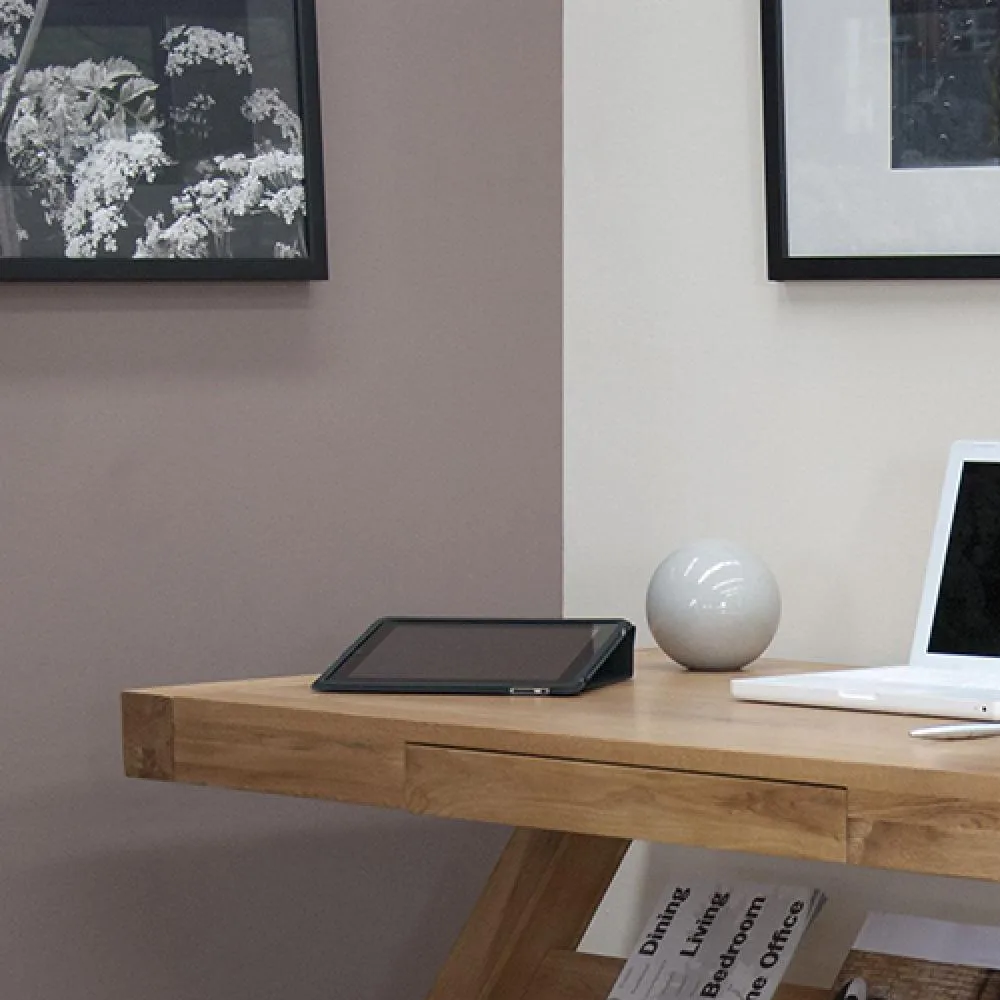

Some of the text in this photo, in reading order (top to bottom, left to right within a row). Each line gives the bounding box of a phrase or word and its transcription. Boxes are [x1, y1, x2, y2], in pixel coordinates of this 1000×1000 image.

[638, 887, 690, 956] Dining
[680, 892, 730, 957] Living
[700, 896, 766, 998] Bedroom
[760, 900, 804, 968] Office
